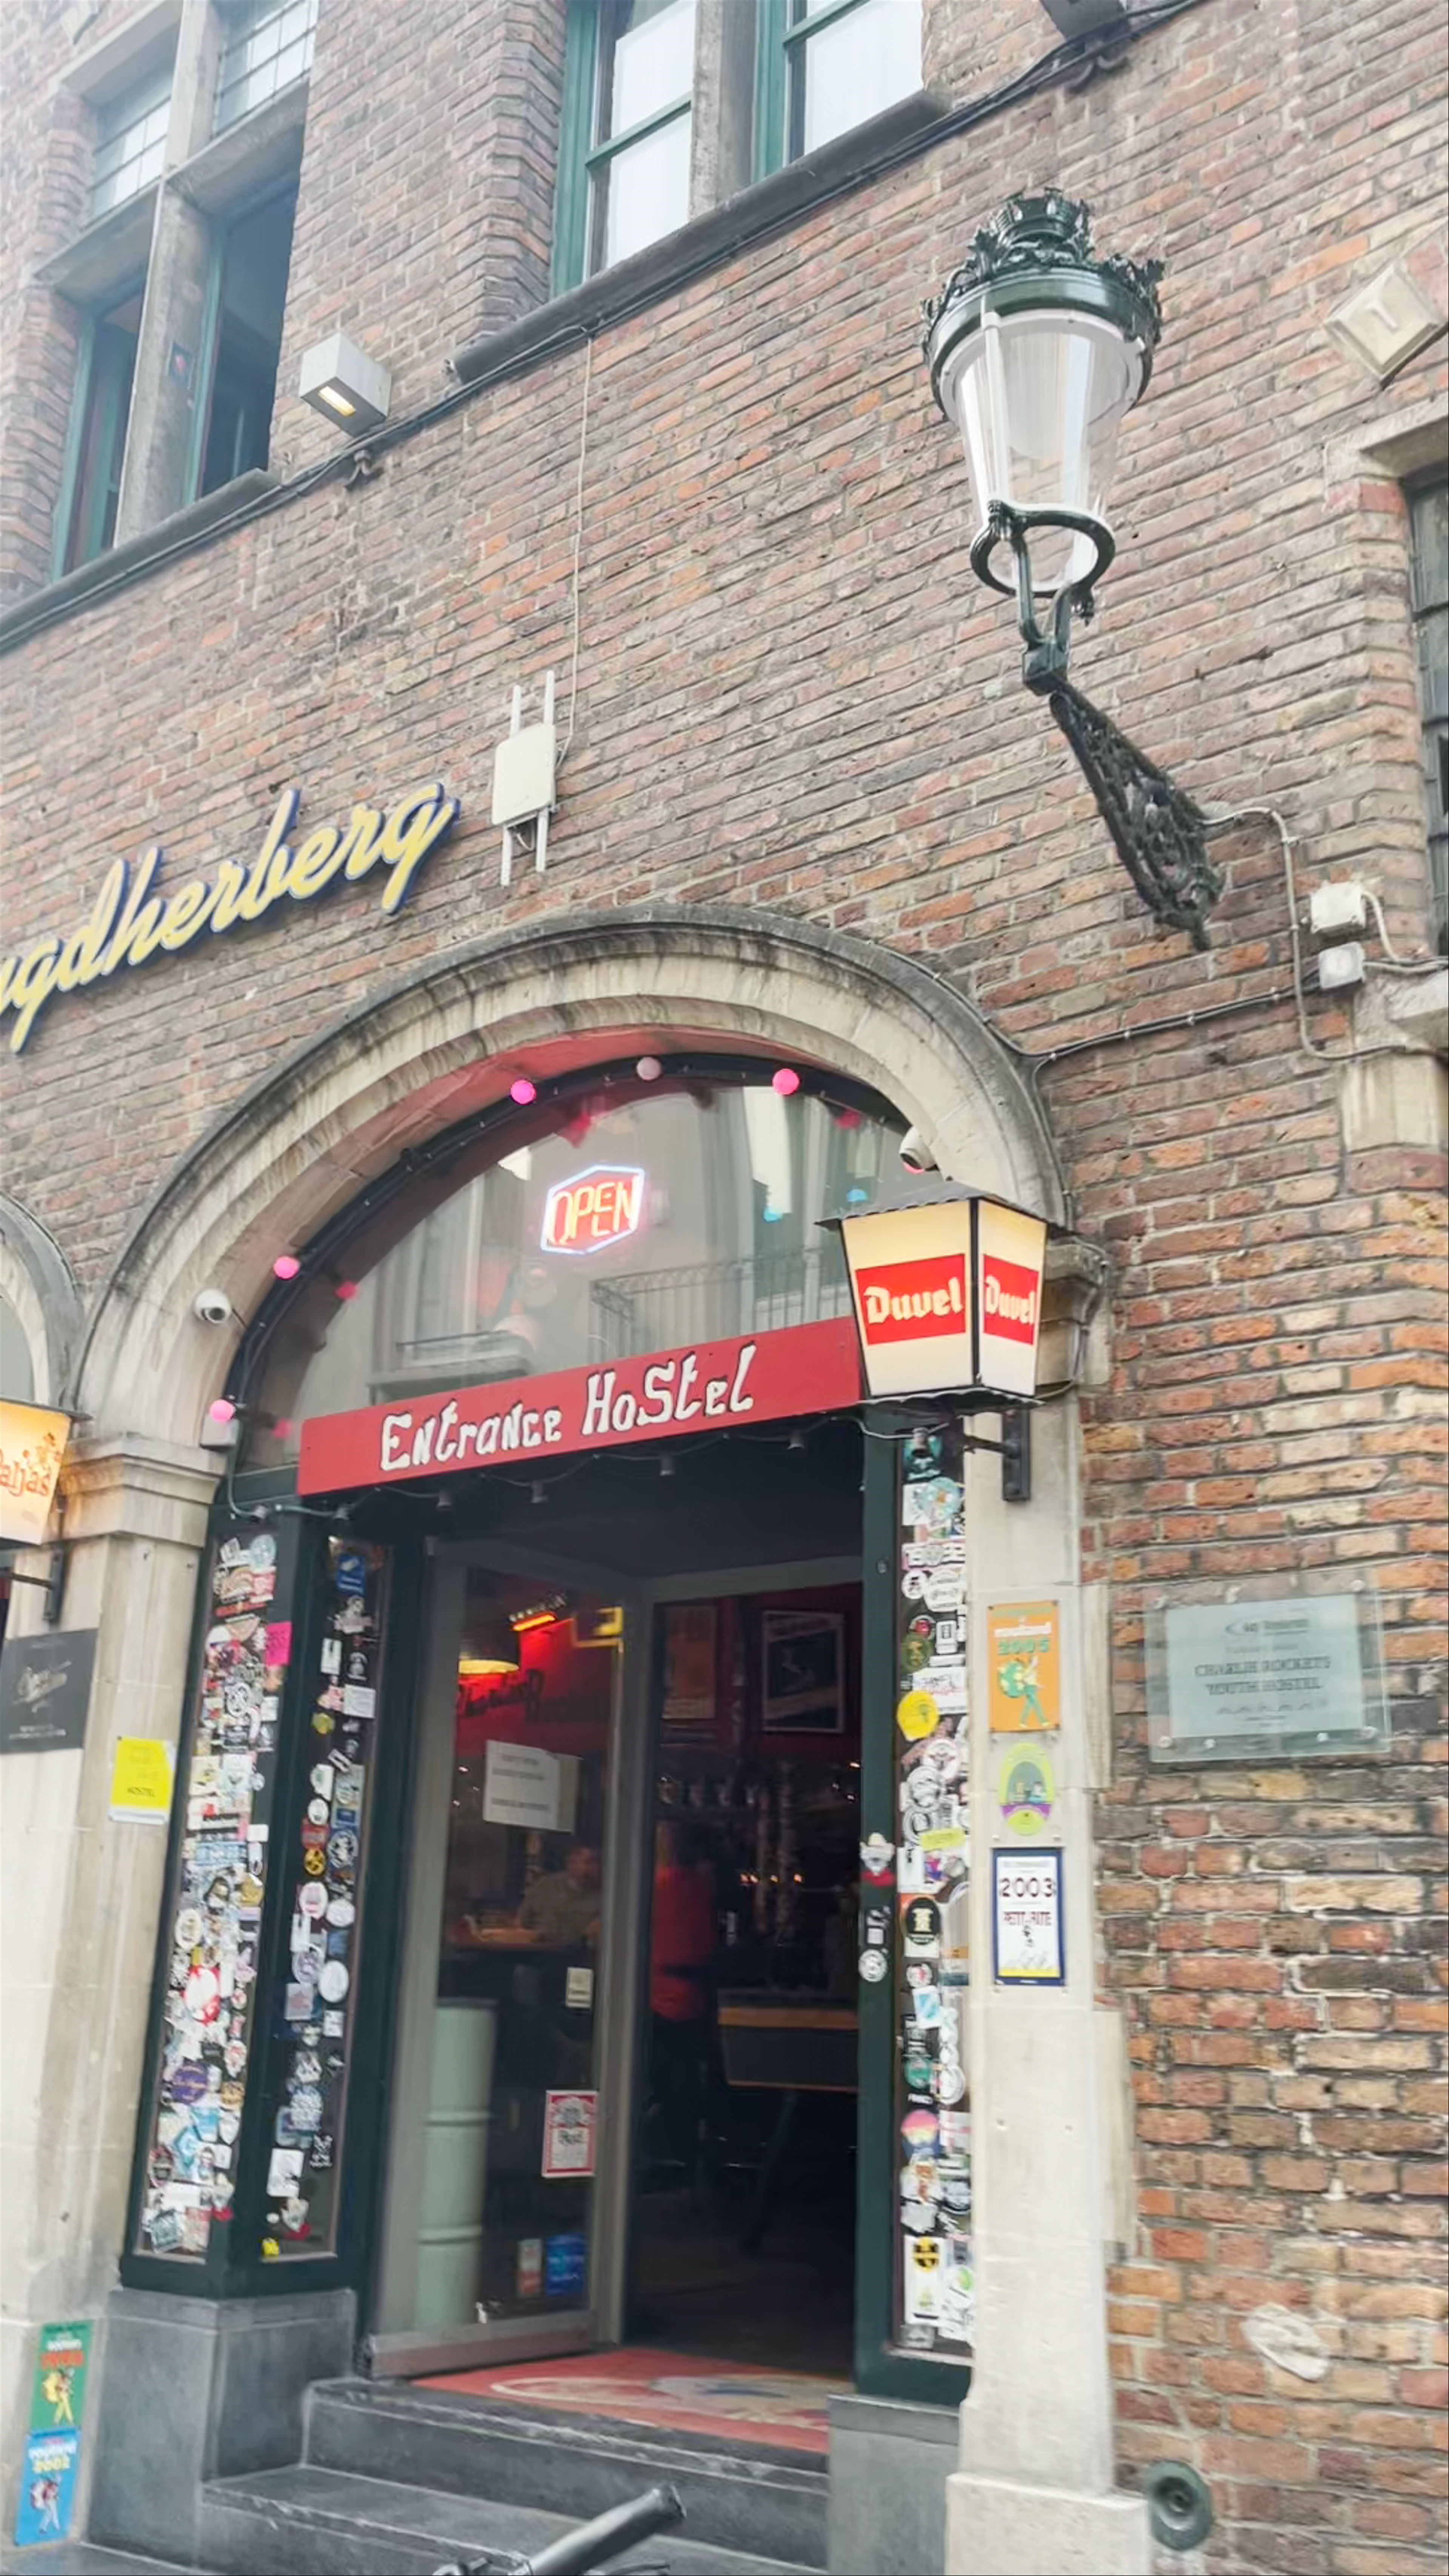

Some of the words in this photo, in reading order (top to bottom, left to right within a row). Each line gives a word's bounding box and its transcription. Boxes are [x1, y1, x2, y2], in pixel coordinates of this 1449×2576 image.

[546, 1174, 638, 1245] OPEN
[863, 1276, 963, 1325] Duvel
[985, 1275, 1035, 1325] Duvel
[1000, 1877, 1055, 1898] 2003
